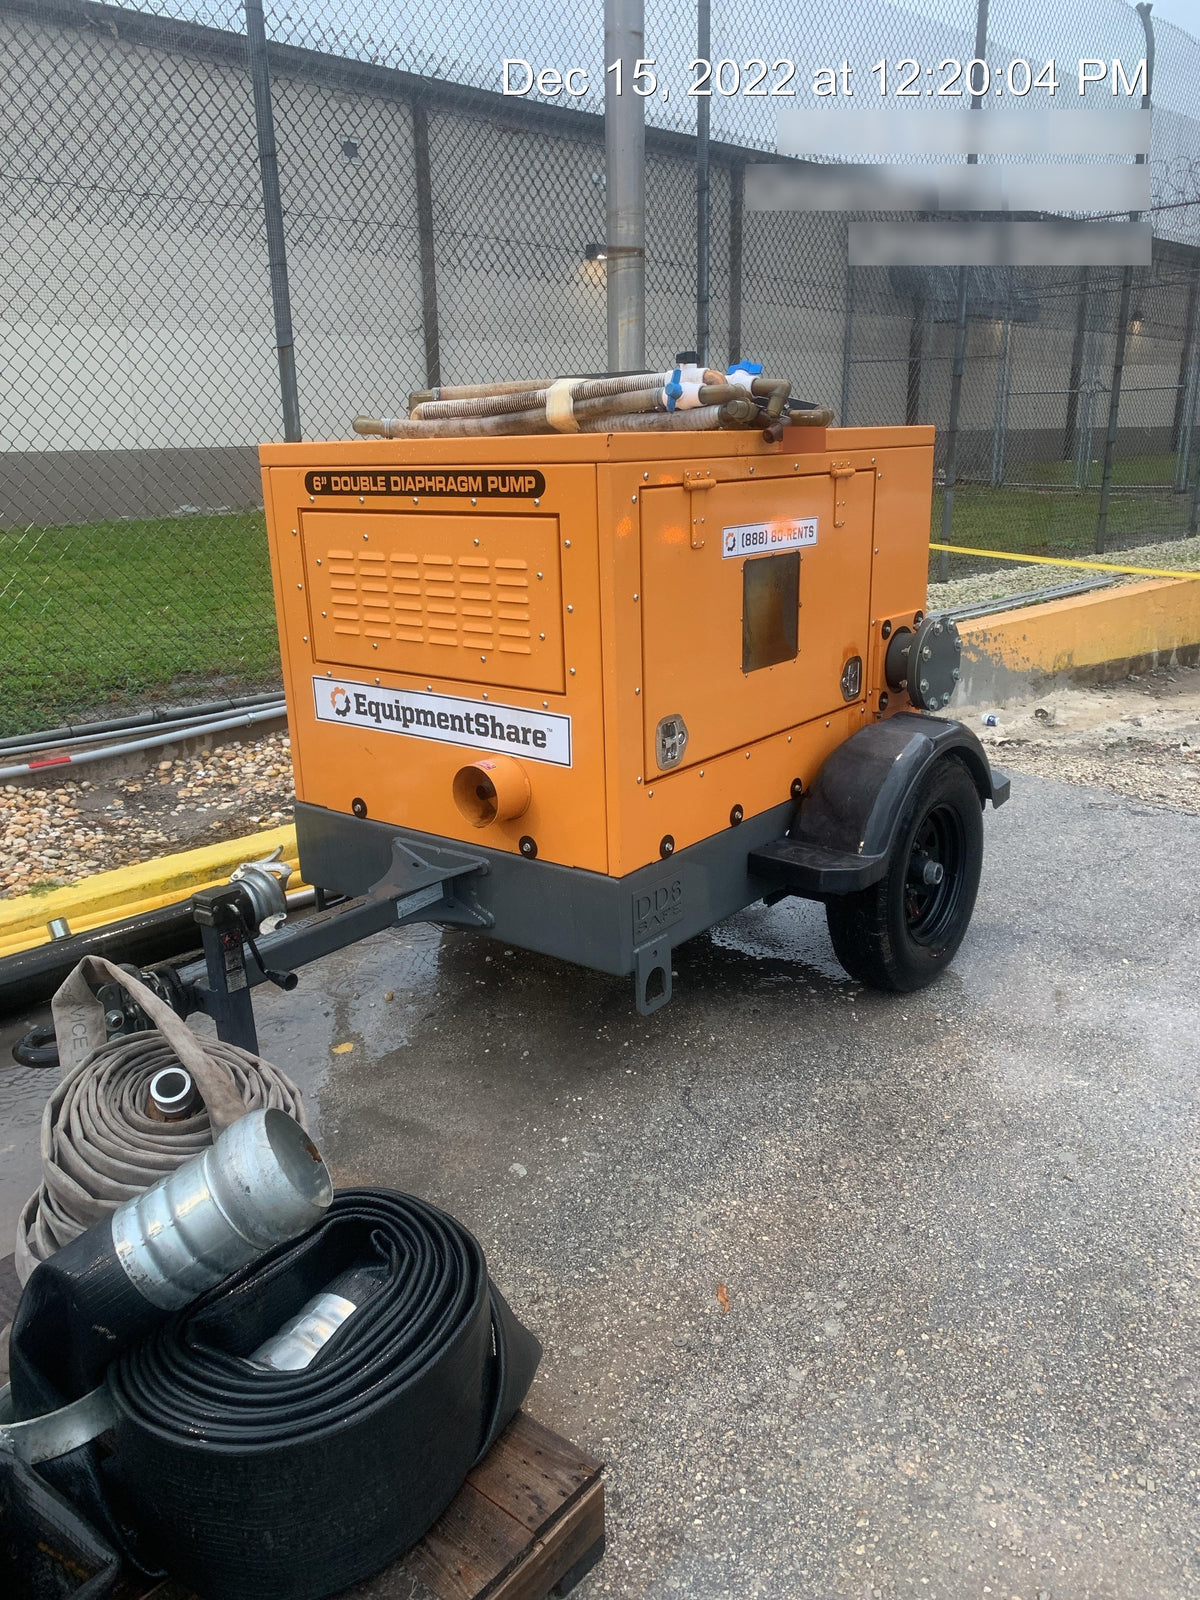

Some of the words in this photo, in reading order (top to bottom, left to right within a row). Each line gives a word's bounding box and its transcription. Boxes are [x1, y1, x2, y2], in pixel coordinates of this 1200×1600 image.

[331, 476, 387, 492] DOUBLE
[390, 476, 483, 493] DIAPHRAGM
[487, 476, 537, 493] PUMP
[741, 530, 768, 548] (888)
[353, 692, 548, 749] EquipmentShare
